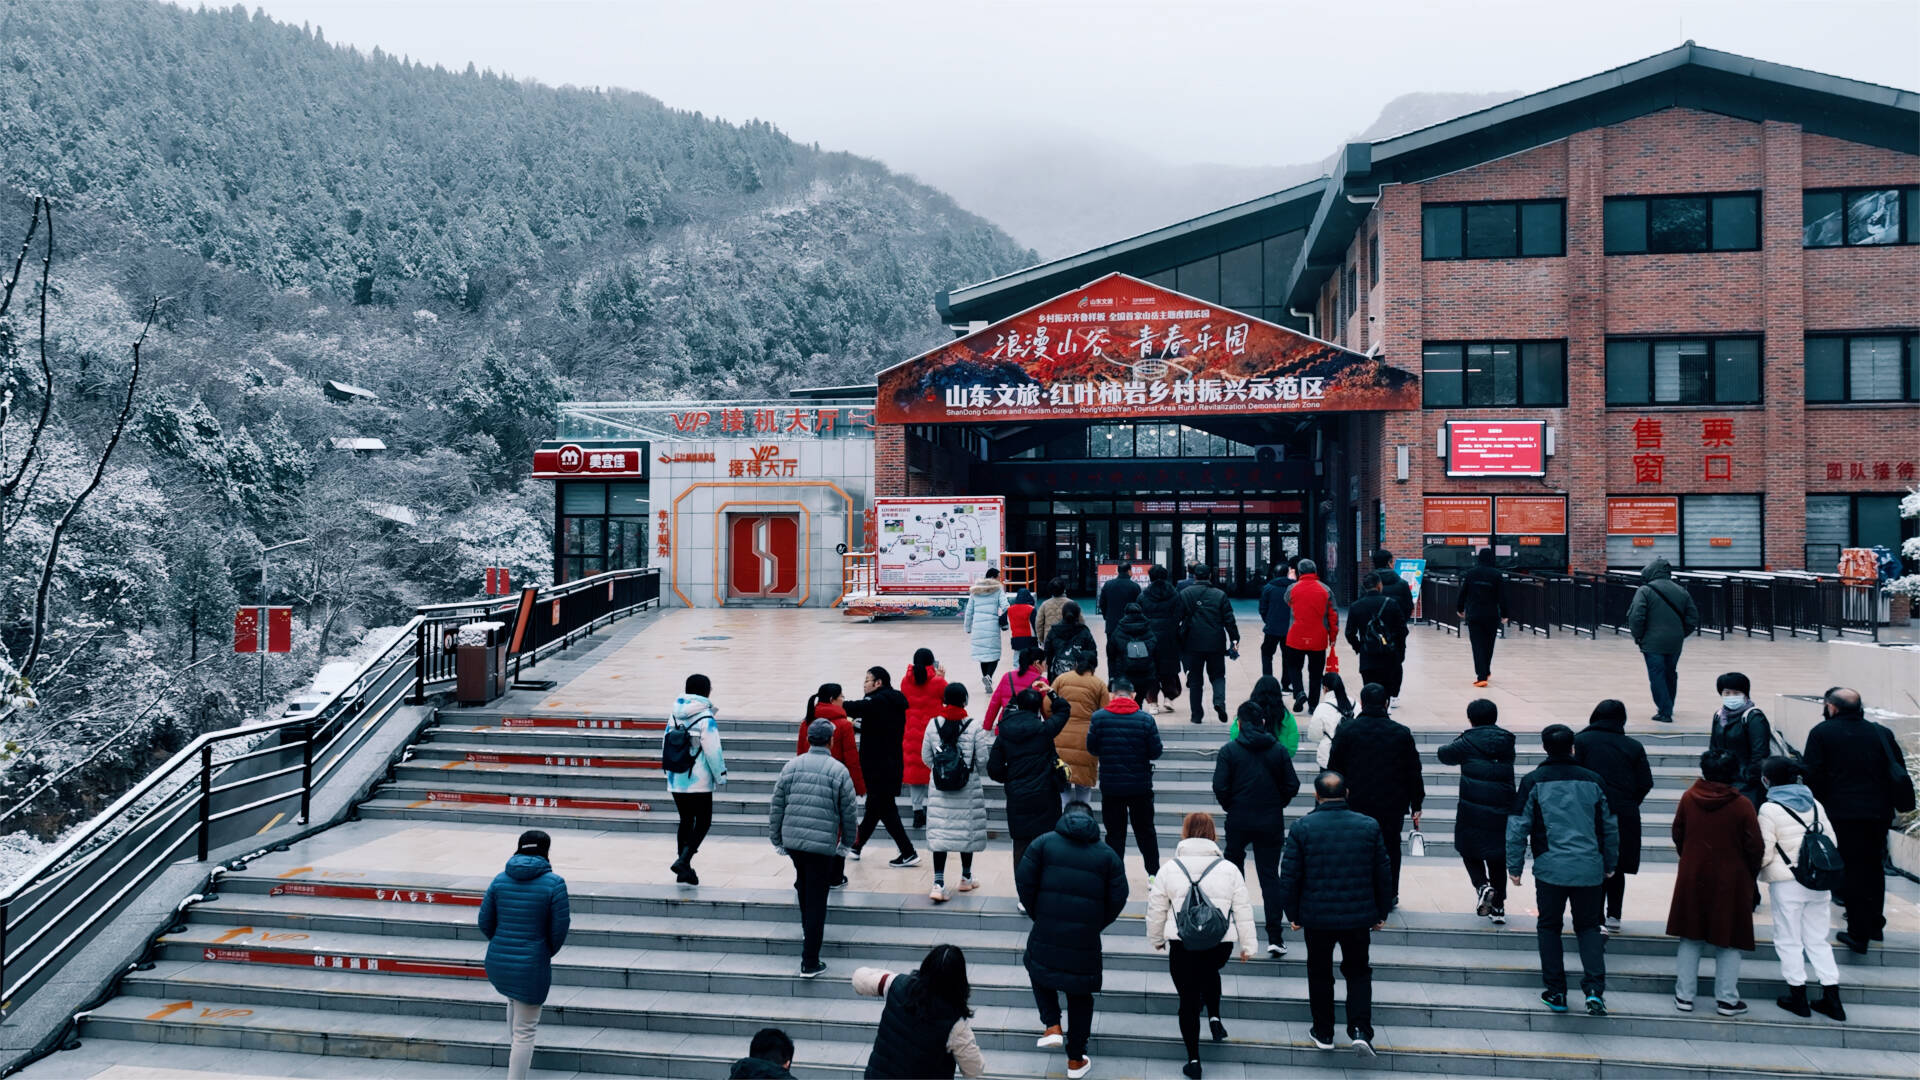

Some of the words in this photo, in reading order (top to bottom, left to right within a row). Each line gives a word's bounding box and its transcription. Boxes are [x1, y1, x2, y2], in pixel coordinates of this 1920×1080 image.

[1038, 312, 1106, 323] 乡村振兴齐鲁样板
[1109, 309, 1210, 321] 全国首家山岳主题度假乐园
[991, 325, 1111, 362] 浪漫山谷
[1130, 322, 1249, 359] 青春乐园
[945, 376, 1325, 408] 山东文旅·红叶柿岩乡村振兴示范区
[669, 411, 711, 432] VIP
[720, 408, 839, 433] 接机大厅
[1632, 417, 1735, 450] 售票
[589, 453, 625, 469] 美宜佳
[750, 445, 779, 461] VIP
[728, 459, 798, 478] 接待大厅
[1632, 452, 1731, 484] 窗口
[1826, 461, 1915, 481] 团队接待
[260, 931, 311, 942] VIP
[198, 1008, 254, 1018] VIP
